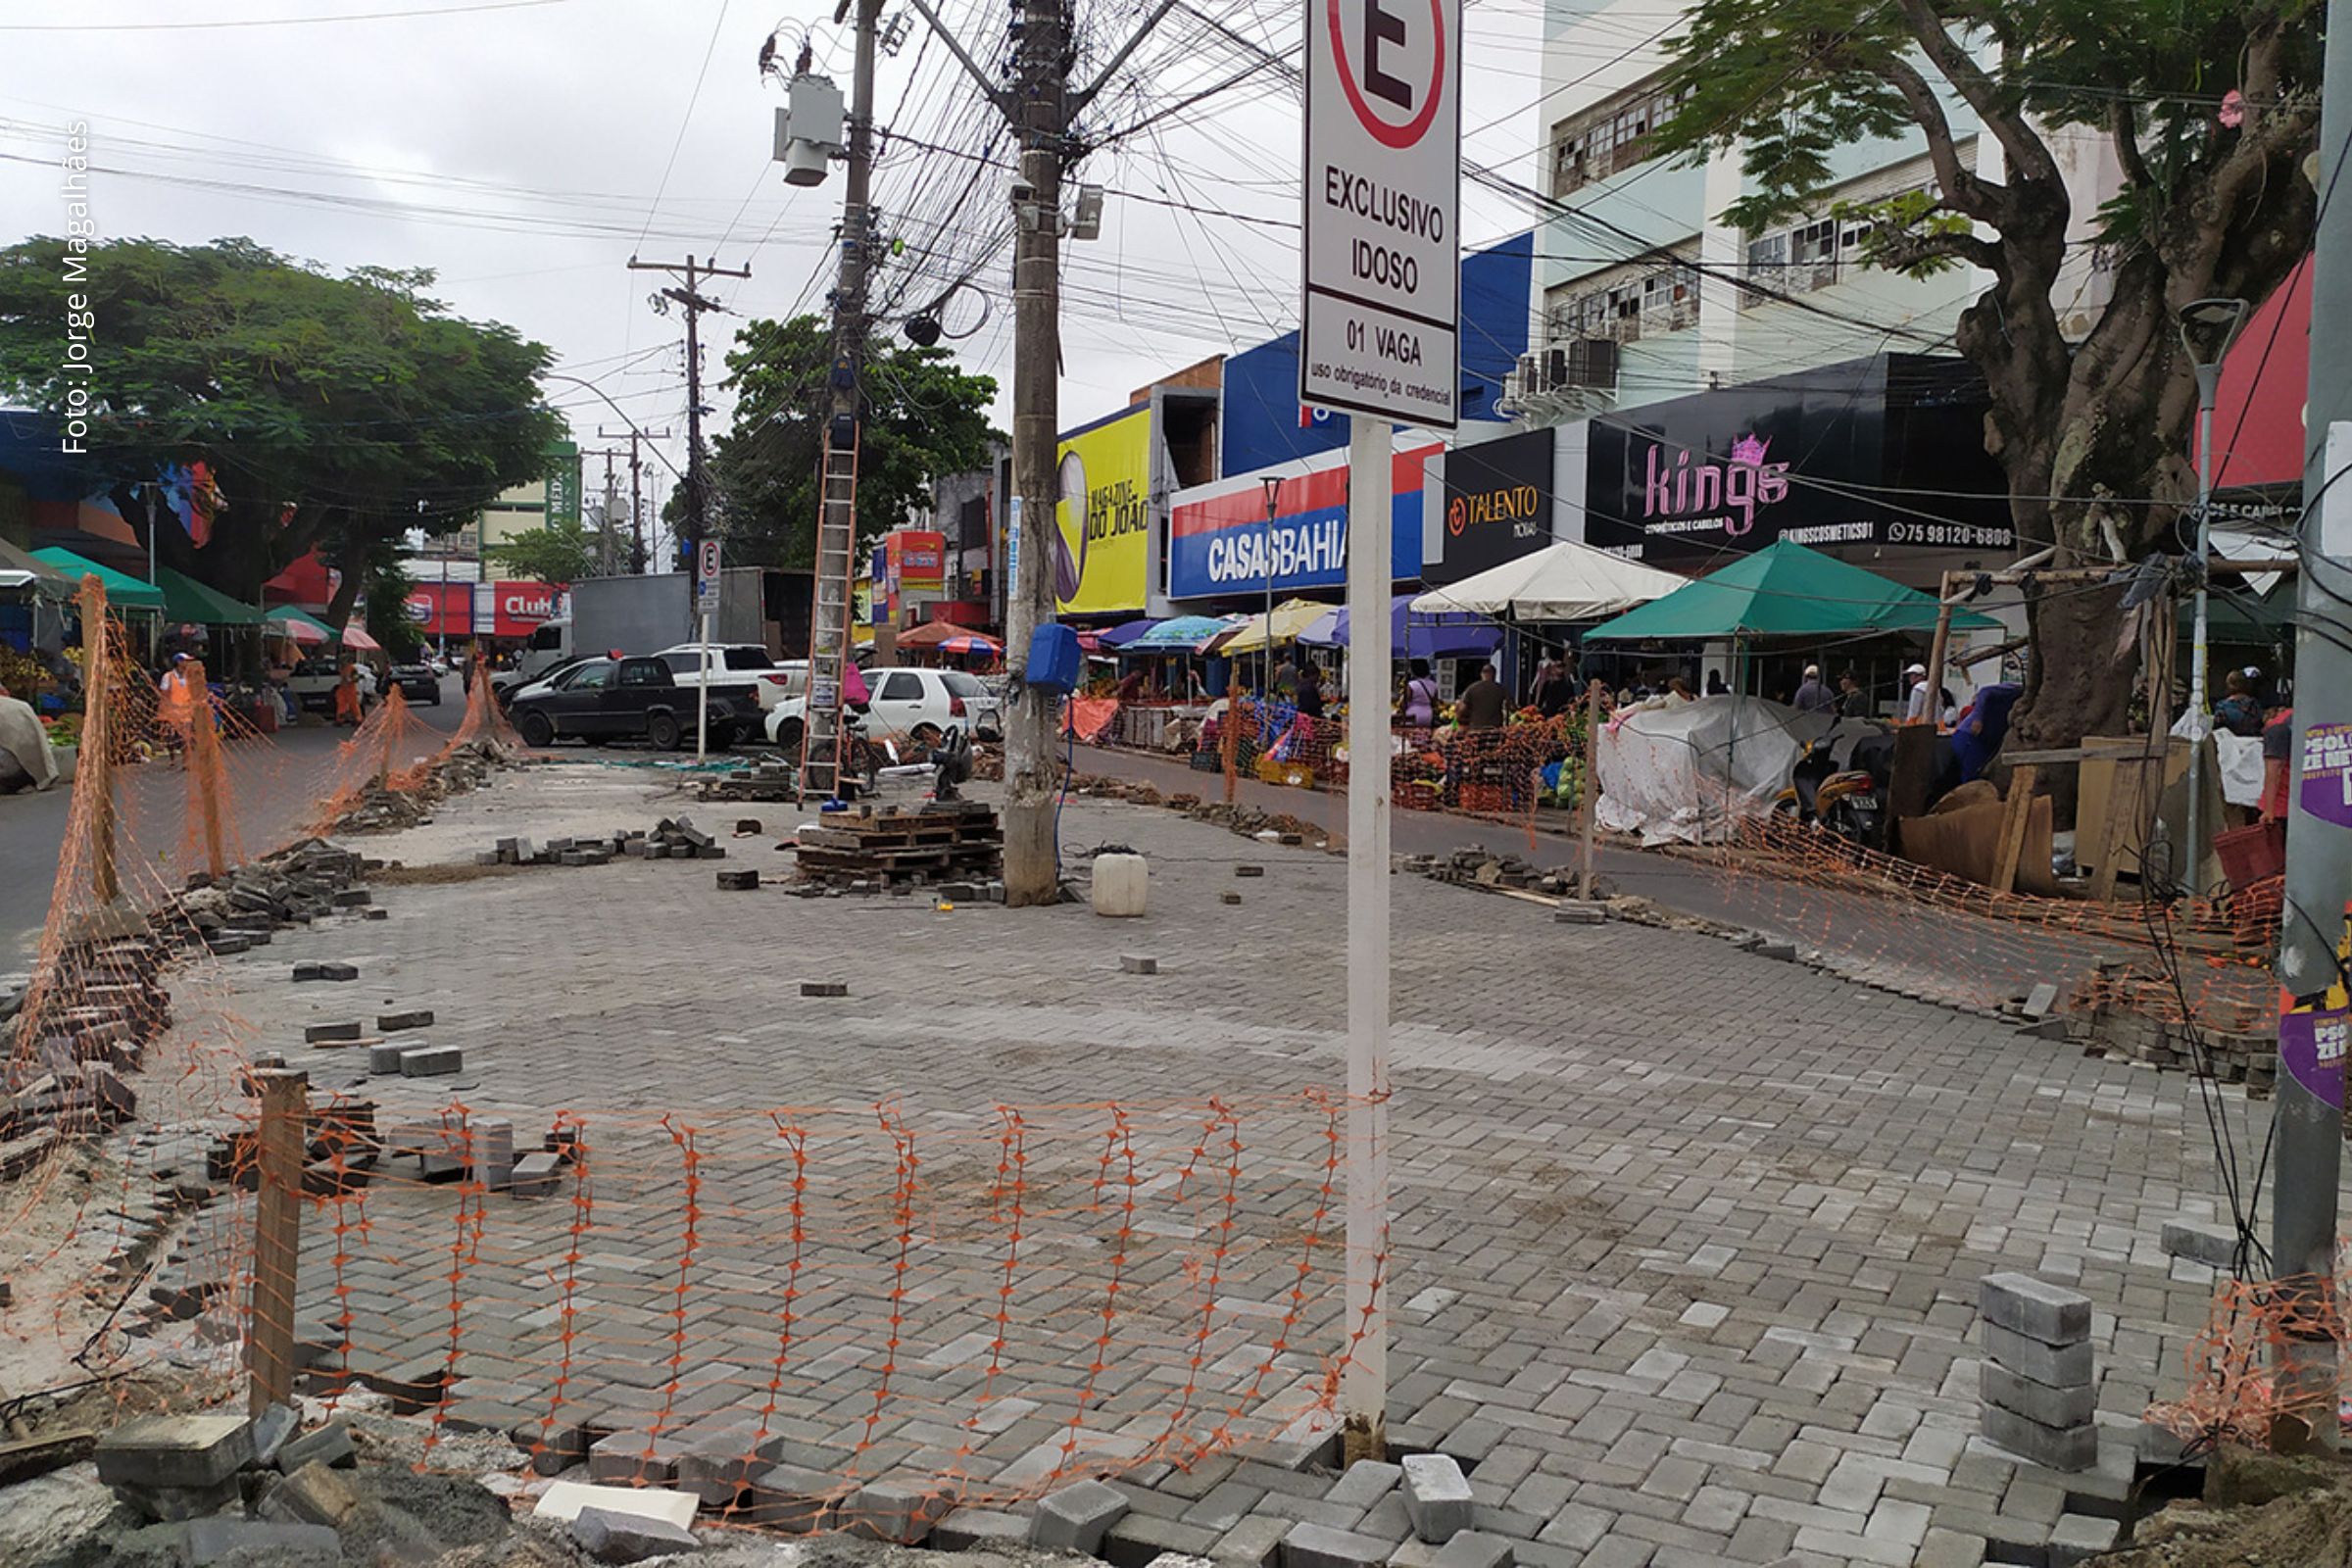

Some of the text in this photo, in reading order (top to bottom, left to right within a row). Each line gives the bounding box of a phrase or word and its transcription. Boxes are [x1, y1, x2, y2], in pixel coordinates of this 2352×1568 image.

[1364, 0, 1412, 111] E
[1326, 165, 1444, 243] EXCLUSIVO
[1351, 238, 1417, 294] IDOSO
[1347, 319, 1422, 366] 01 VAGA
[1310, 362, 1452, 407] uso obrigatório da credencial
[1091, 479, 1134, 511] MAGAZINE
[1467, 485, 1537, 524] TALENTO
[1643, 444, 1789, 535] kings
[1090, 494, 1149, 540] DO JOÃO
[1907, 524, 1924, 542] 75
[2325, 750, 2352, 768] NE
